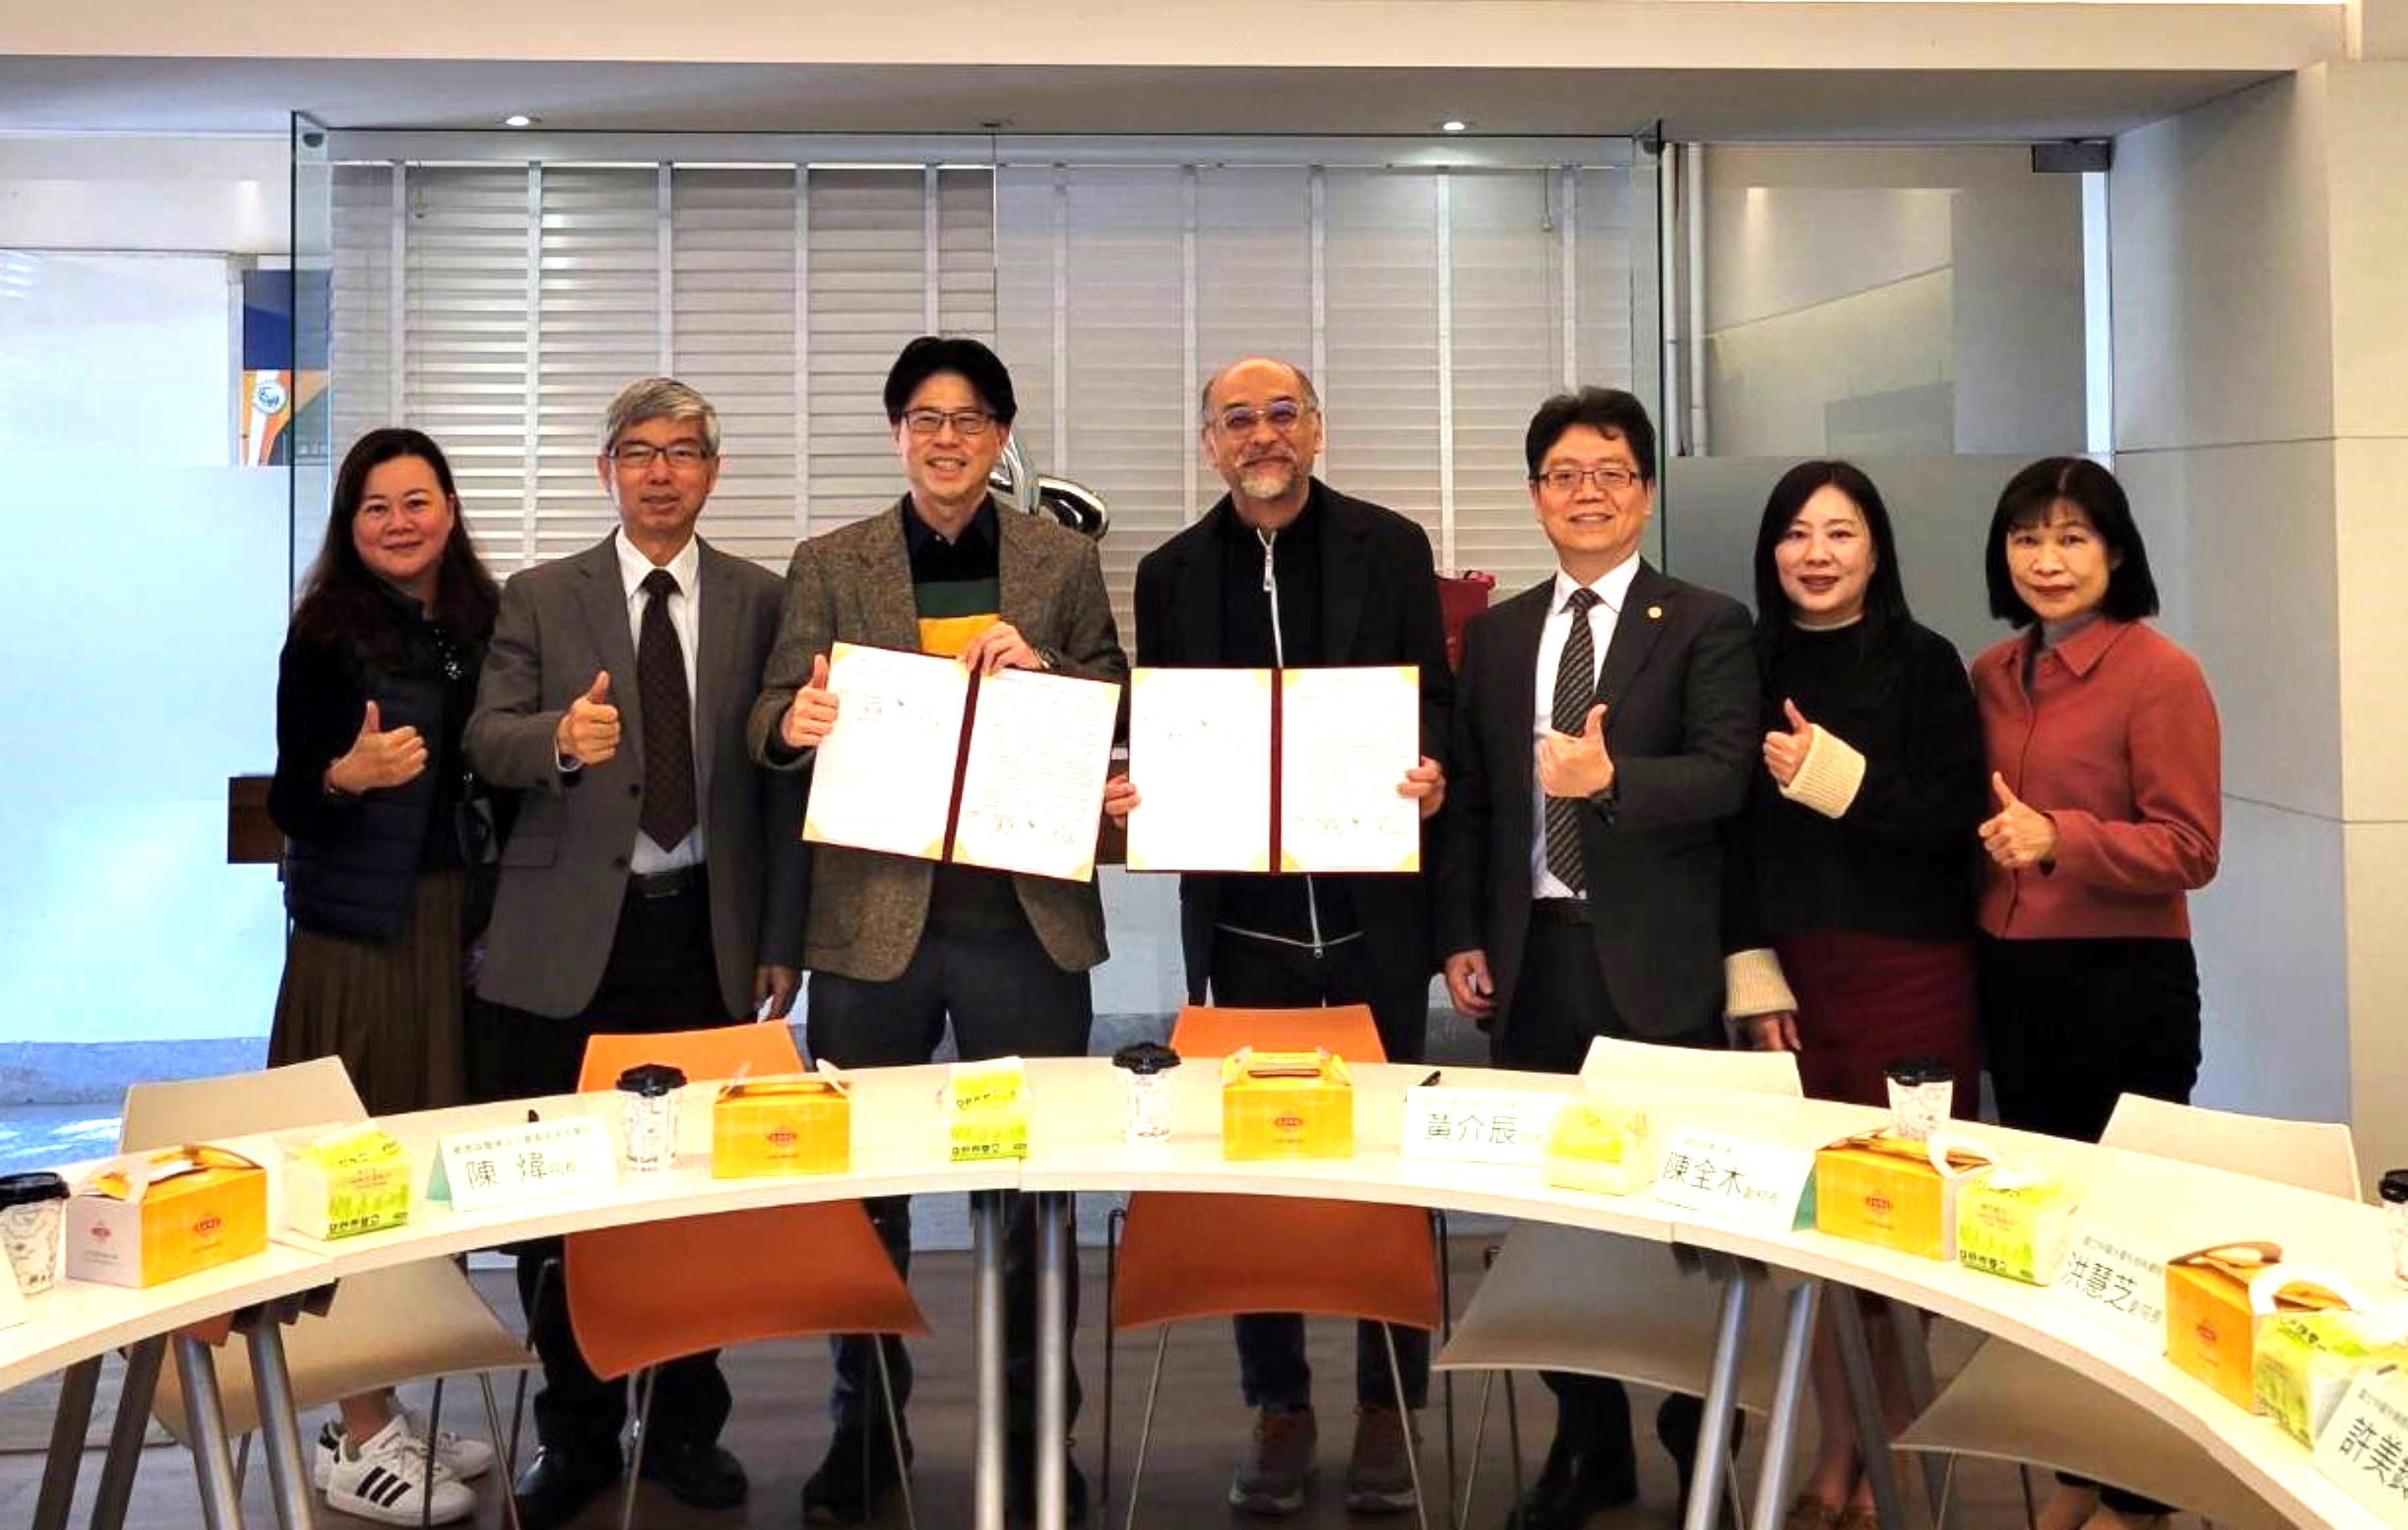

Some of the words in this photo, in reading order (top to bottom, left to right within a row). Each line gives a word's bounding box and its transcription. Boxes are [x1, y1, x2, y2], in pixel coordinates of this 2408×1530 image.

[1424, 1113, 1519, 1145] 黃介辰
[1662, 1151, 1746, 1197] 陳全木
[2058, 1250, 2139, 1311] 洪慧芝
